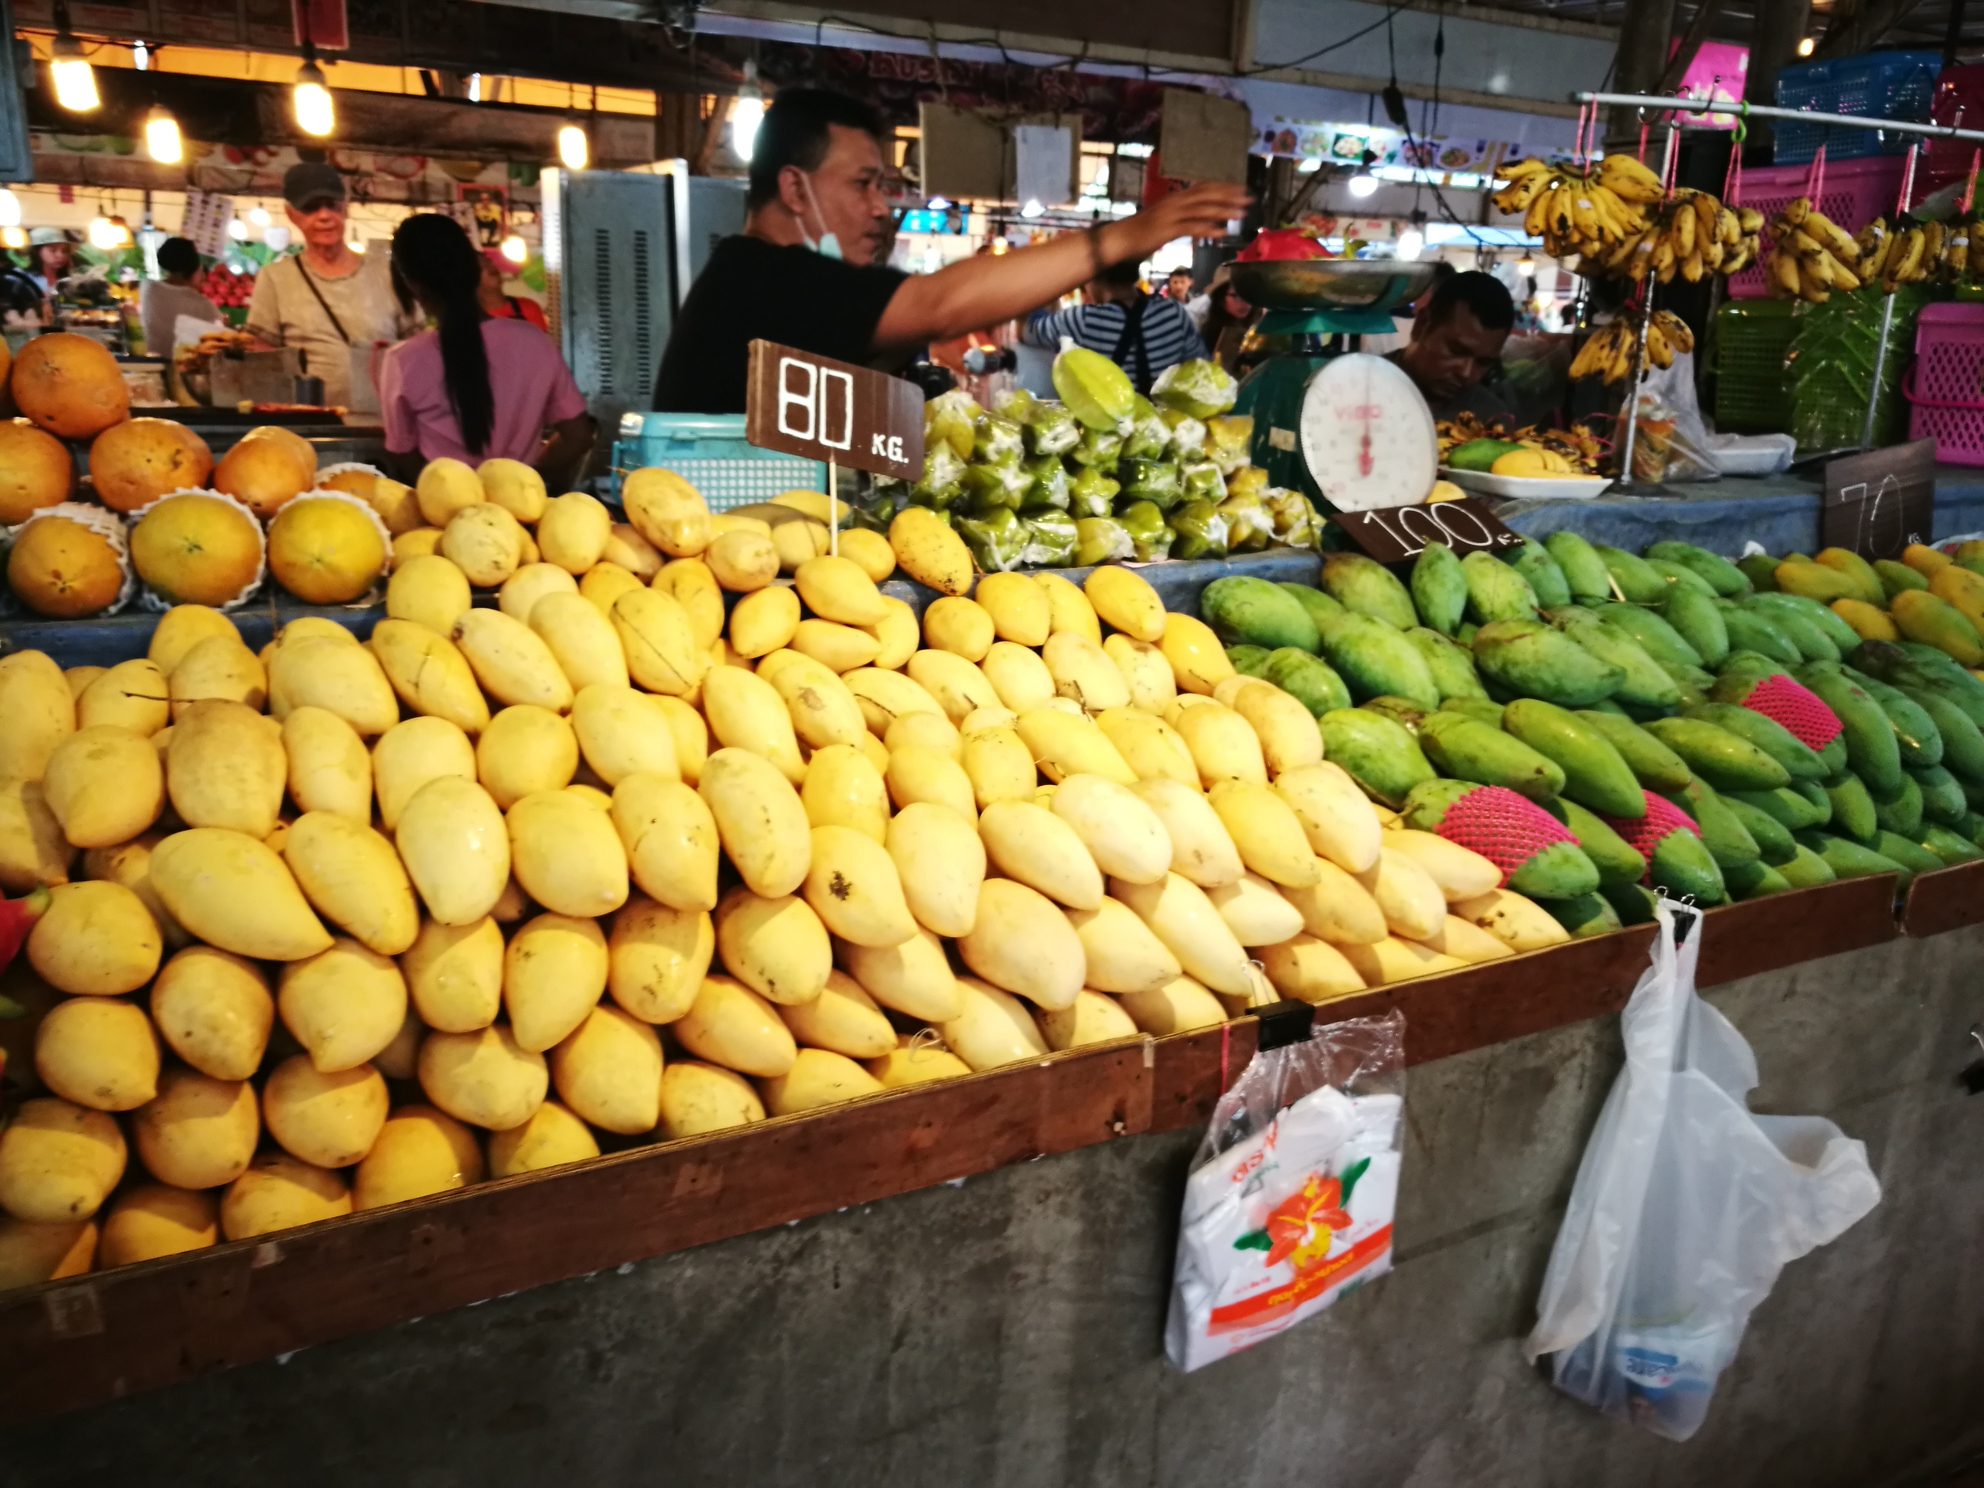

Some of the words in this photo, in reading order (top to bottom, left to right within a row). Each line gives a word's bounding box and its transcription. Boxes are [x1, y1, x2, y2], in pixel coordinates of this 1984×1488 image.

[778, 357, 853, 450] 80
[871, 433, 909, 463] KG.
[1363, 502, 1493, 556] 100
[1841, 474, 1904, 556] 70
